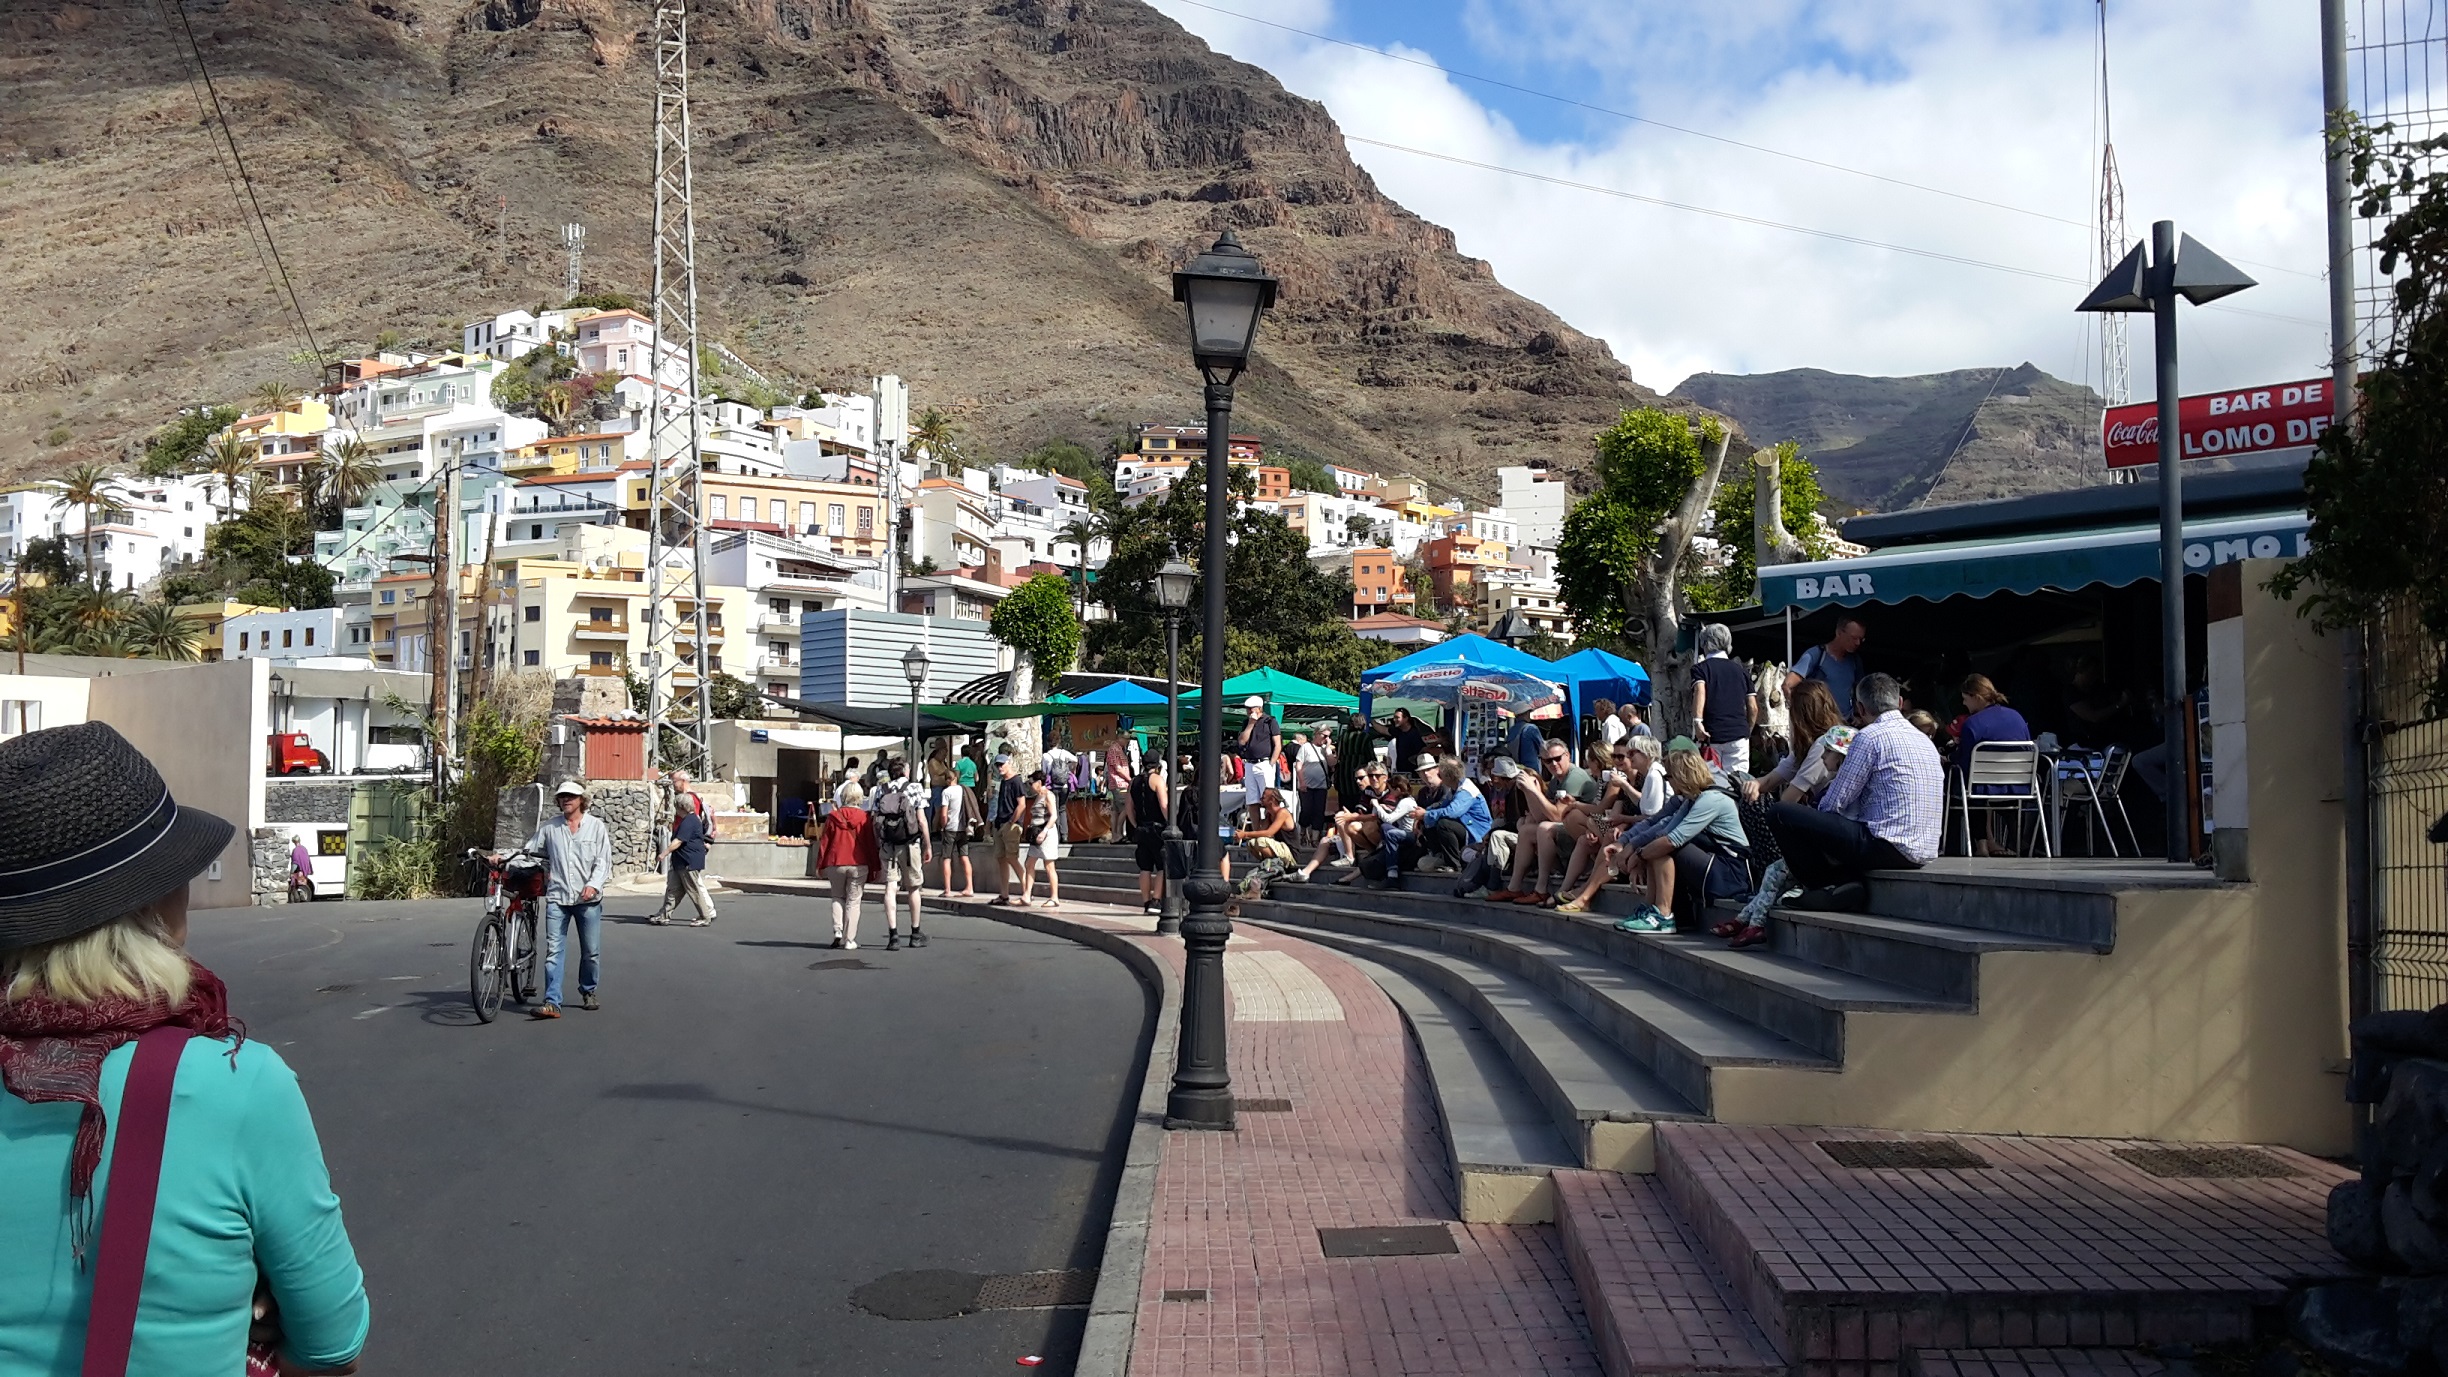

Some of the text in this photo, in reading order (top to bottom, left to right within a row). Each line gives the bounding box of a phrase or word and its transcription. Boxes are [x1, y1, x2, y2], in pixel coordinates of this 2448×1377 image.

[2209, 383, 2323, 416] BAR DE
[2107, 416, 2160, 449] Coca-Col
[2183, 423, 2276, 455] LOMO
[2159, 534, 2281, 568] OMO
[1795, 573, 1876, 600] BAR
